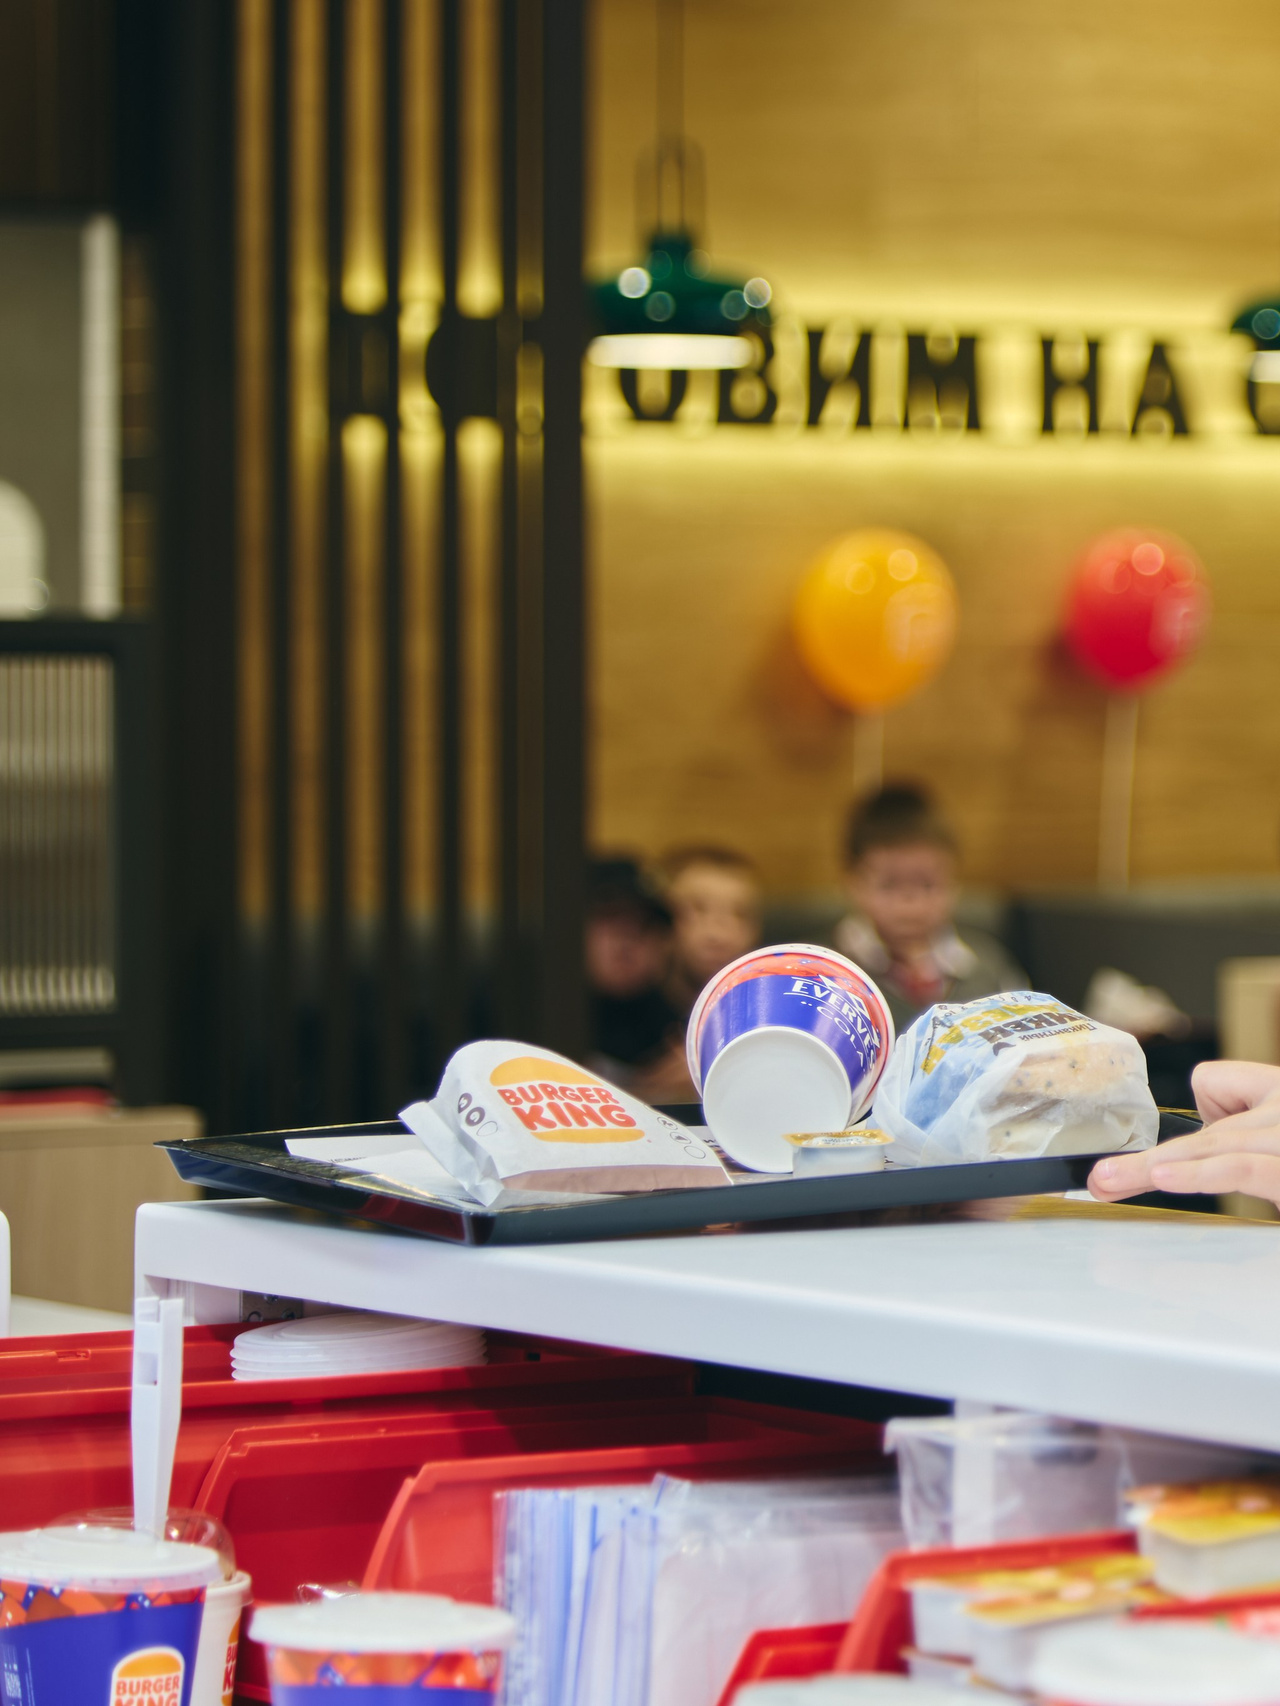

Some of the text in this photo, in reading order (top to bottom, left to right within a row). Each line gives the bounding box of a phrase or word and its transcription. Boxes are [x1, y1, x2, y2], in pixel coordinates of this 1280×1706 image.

[1040, 338, 1191, 436] НА
[1018, 1023, 1098, 1042] Пикантный
[497, 1083, 620, 1106] BURGER
[512, 1101, 637, 1131] KING
[115, 1674, 180, 1698] BURGER
